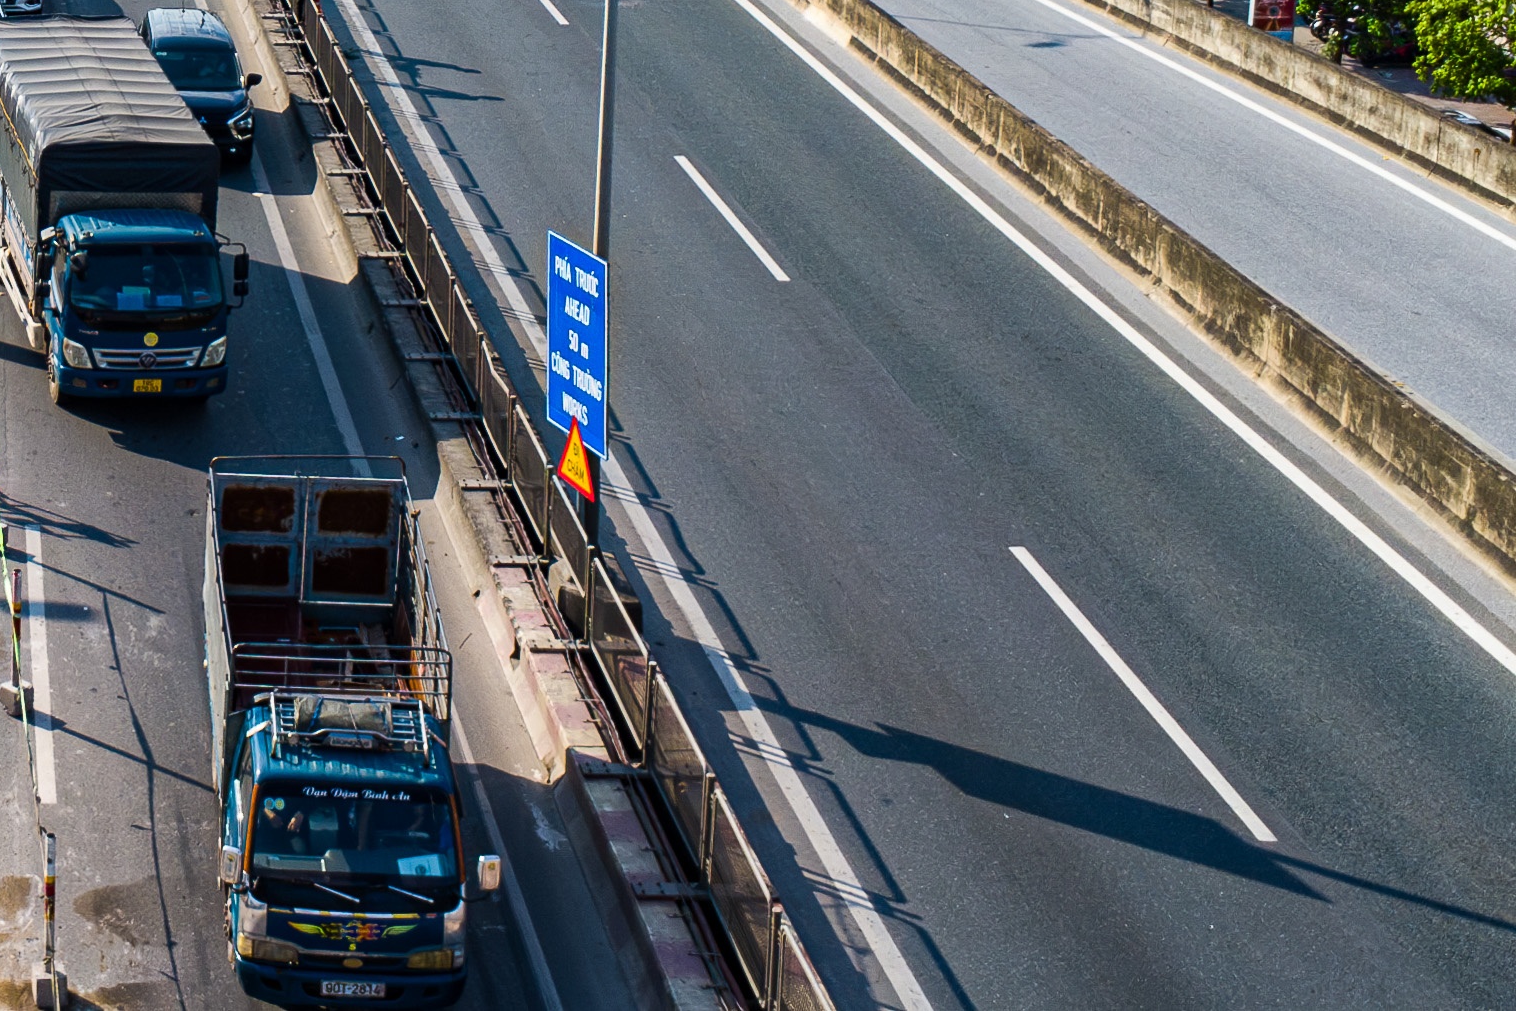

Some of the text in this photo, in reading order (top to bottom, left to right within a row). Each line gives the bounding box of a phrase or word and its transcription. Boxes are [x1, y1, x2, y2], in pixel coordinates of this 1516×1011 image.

[554, 254, 571, 284] PHÍA
[564, 295, 591, 327] AHEAD
[568, 329, 589, 360] 50 m
[551, 350, 571, 381] CÔNG
[562, 390, 589, 427] WORKS
[391, 791, 411, 801] An
